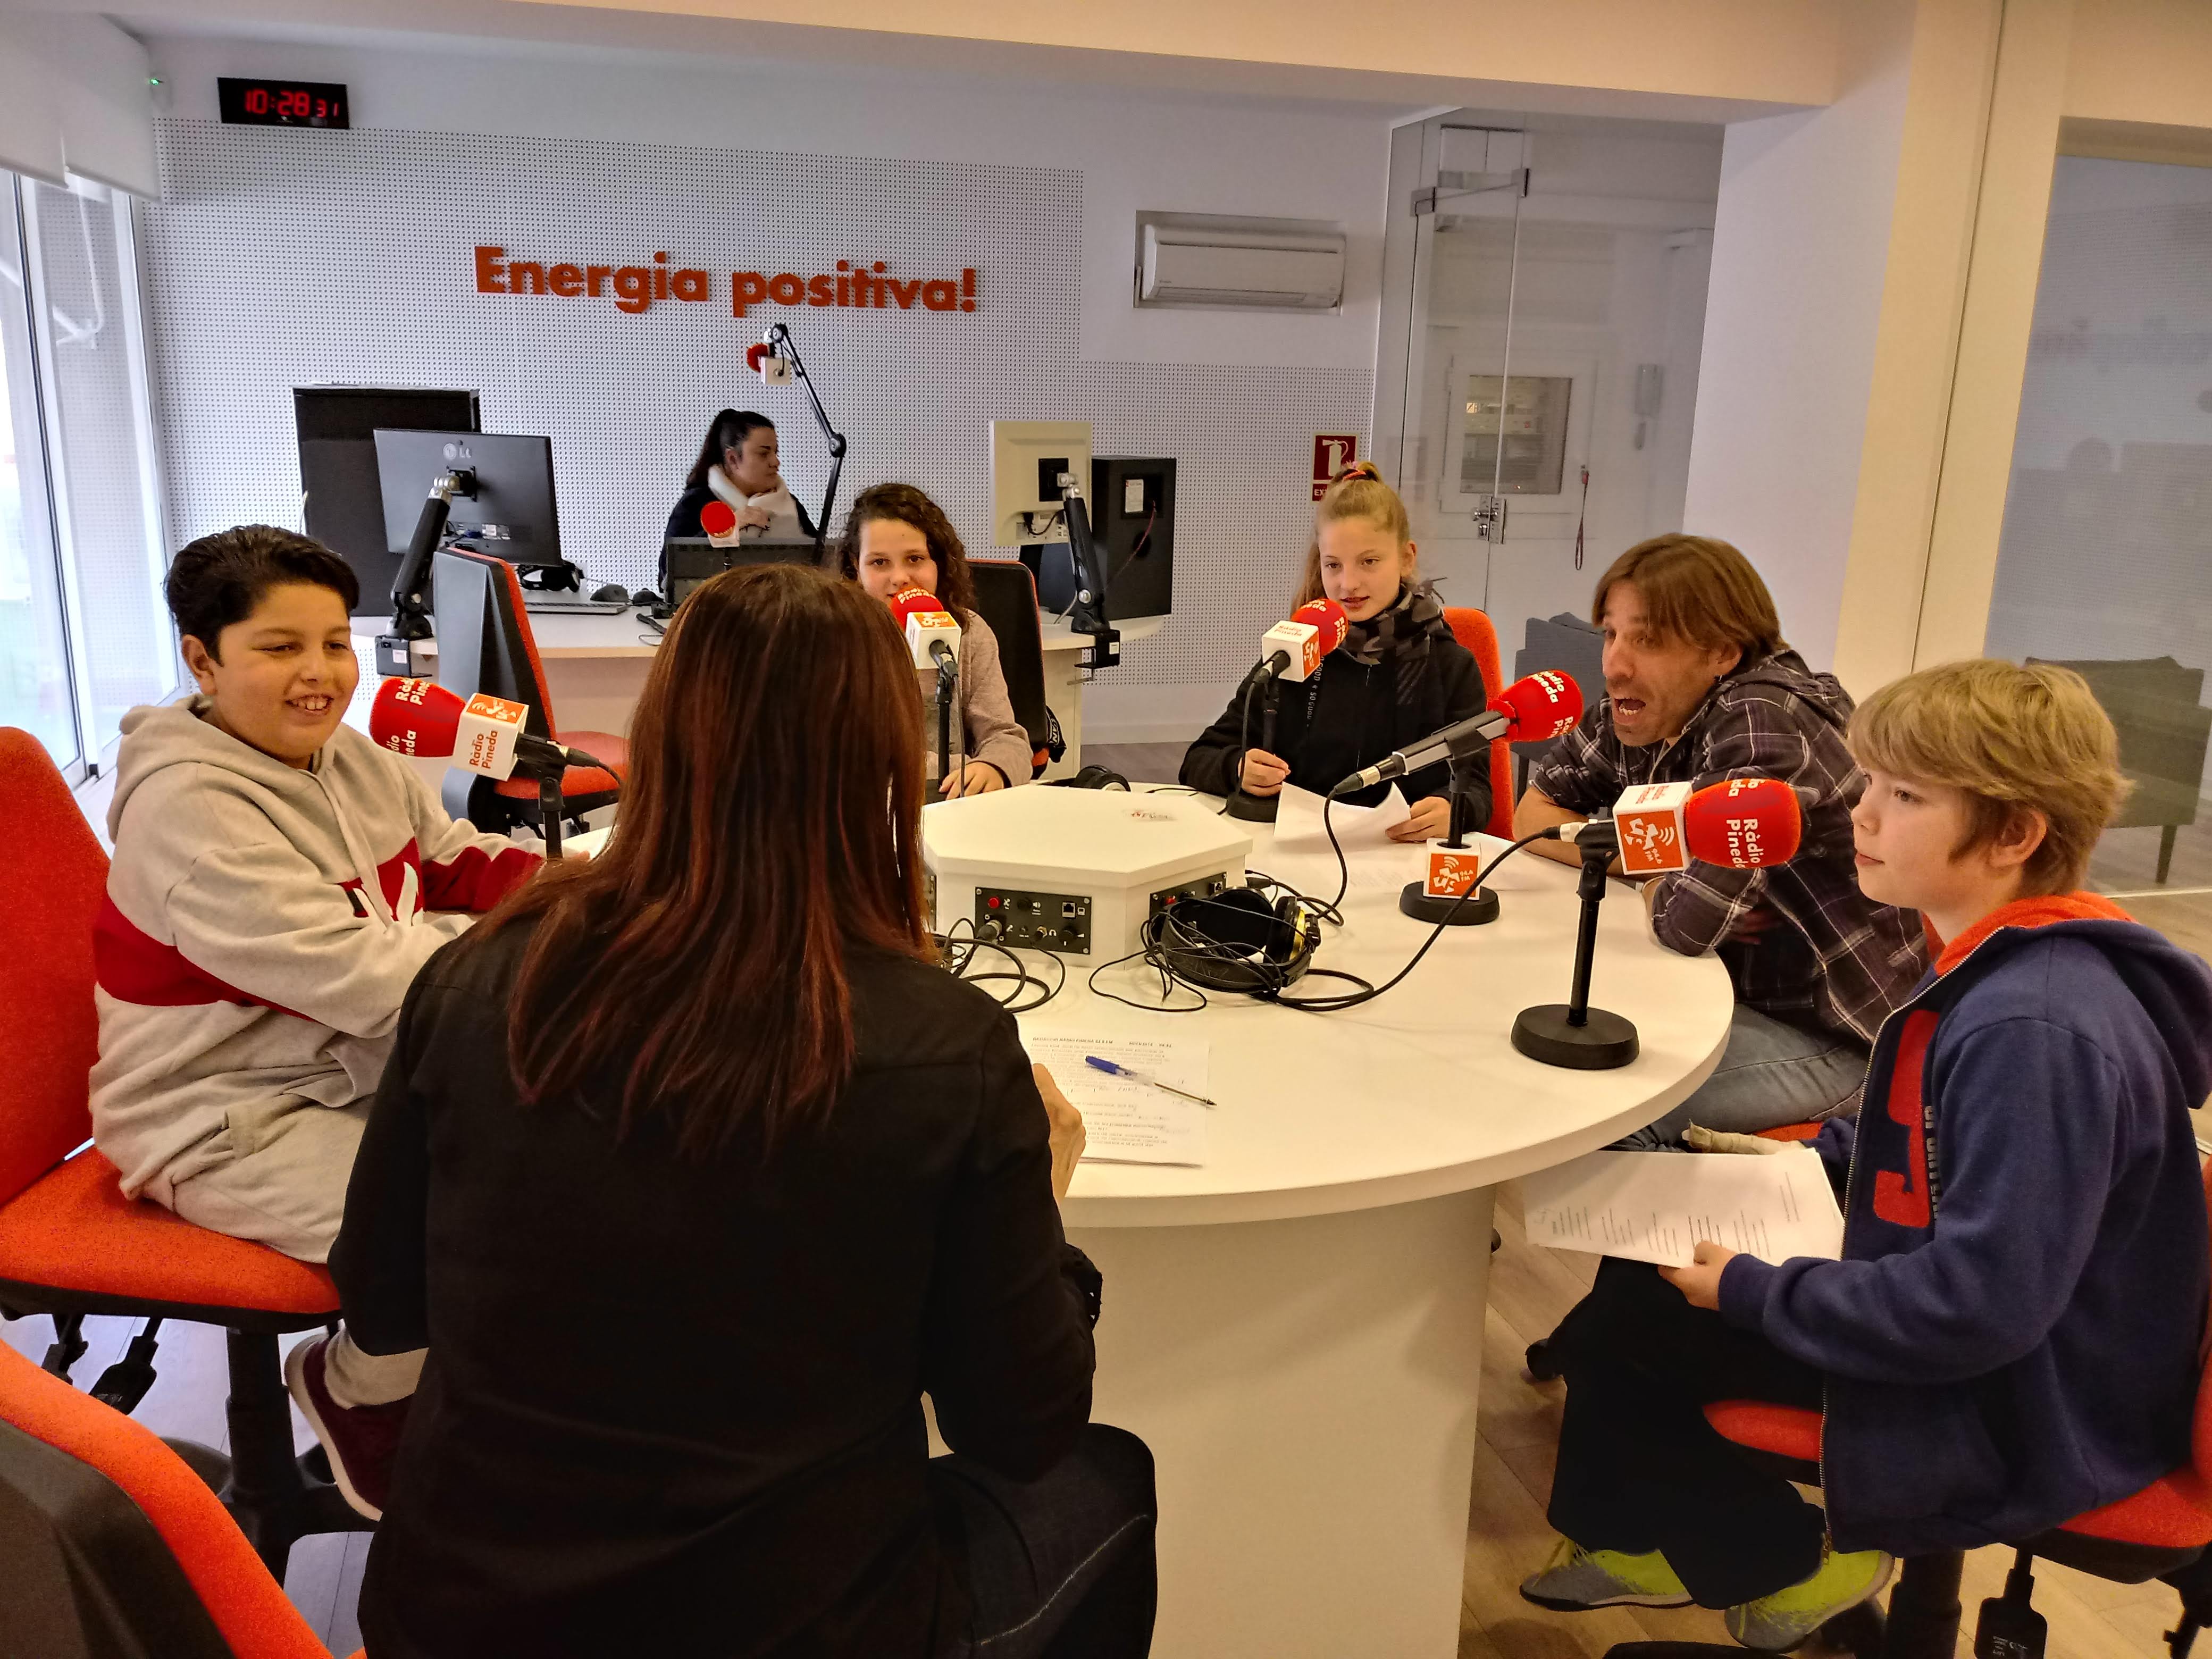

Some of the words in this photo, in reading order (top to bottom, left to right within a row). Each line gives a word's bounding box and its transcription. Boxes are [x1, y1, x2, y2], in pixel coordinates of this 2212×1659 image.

[245, 89, 310, 117] 10:28
[474, 246, 709, 314] Energia
[732, 259, 977, 318] positiva!
[481, 730, 498, 769] Pineda
[1726, 819, 1749, 868] Pineda
[1743, 819, 1765, 864] Ràdio
